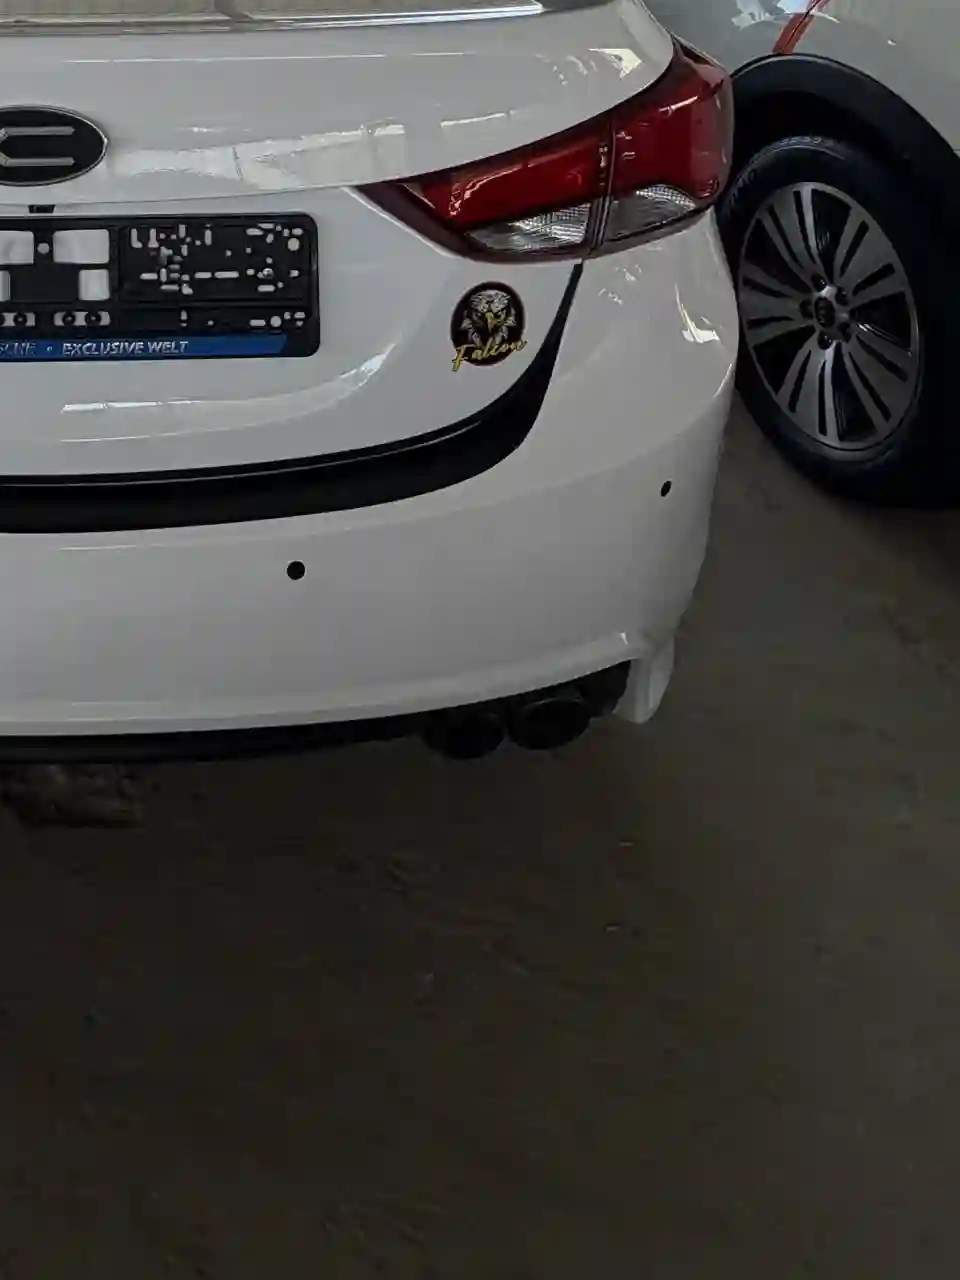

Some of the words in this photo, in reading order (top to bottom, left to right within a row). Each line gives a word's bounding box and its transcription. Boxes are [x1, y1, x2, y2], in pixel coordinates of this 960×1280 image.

[62, 341, 144, 356] EXCLUSIVE
[148, 341, 189, 354] WELT
[451, 337, 528, 372] Falcon
